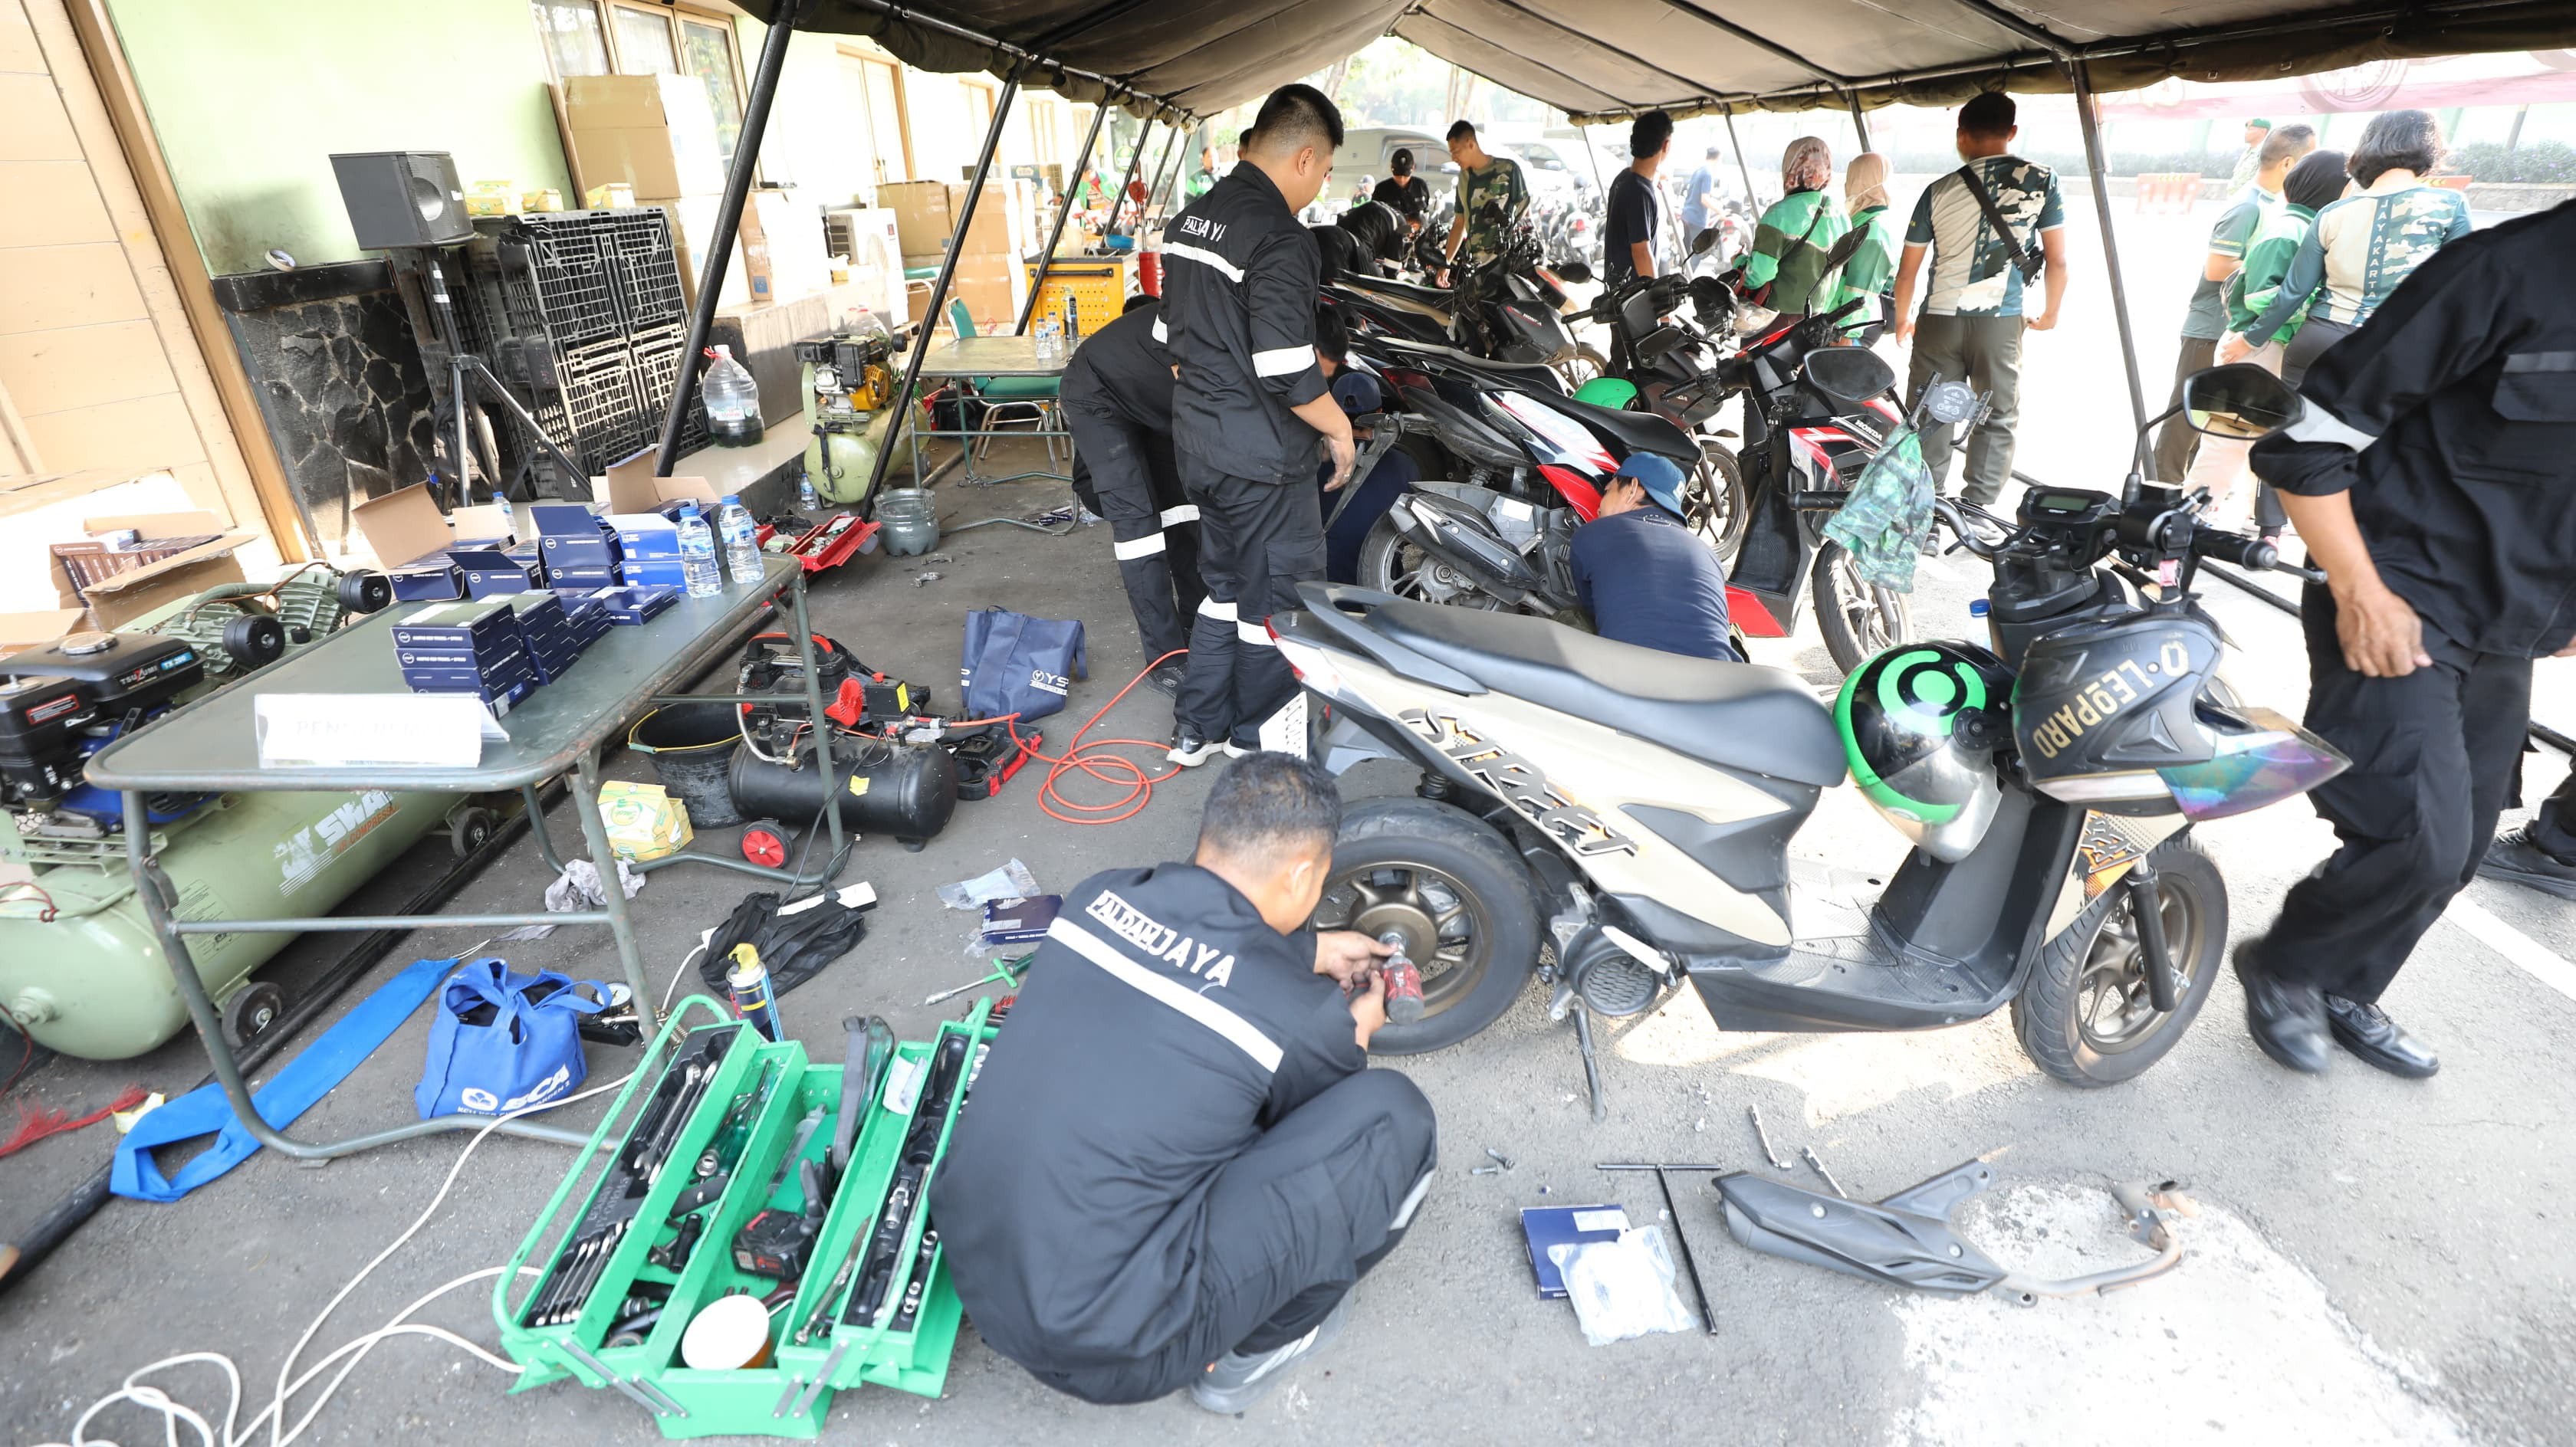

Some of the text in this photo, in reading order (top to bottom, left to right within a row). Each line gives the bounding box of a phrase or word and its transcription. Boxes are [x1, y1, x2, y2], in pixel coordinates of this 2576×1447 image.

[1974, 165, 1996, 265] JAYARTA
[2367, 199, 2389, 298] JAYAKARTA
[1855, 419, 1883, 441] HONDA
[120, 665, 158, 685] TSUZUMI
[1045, 673, 1070, 687] YS
